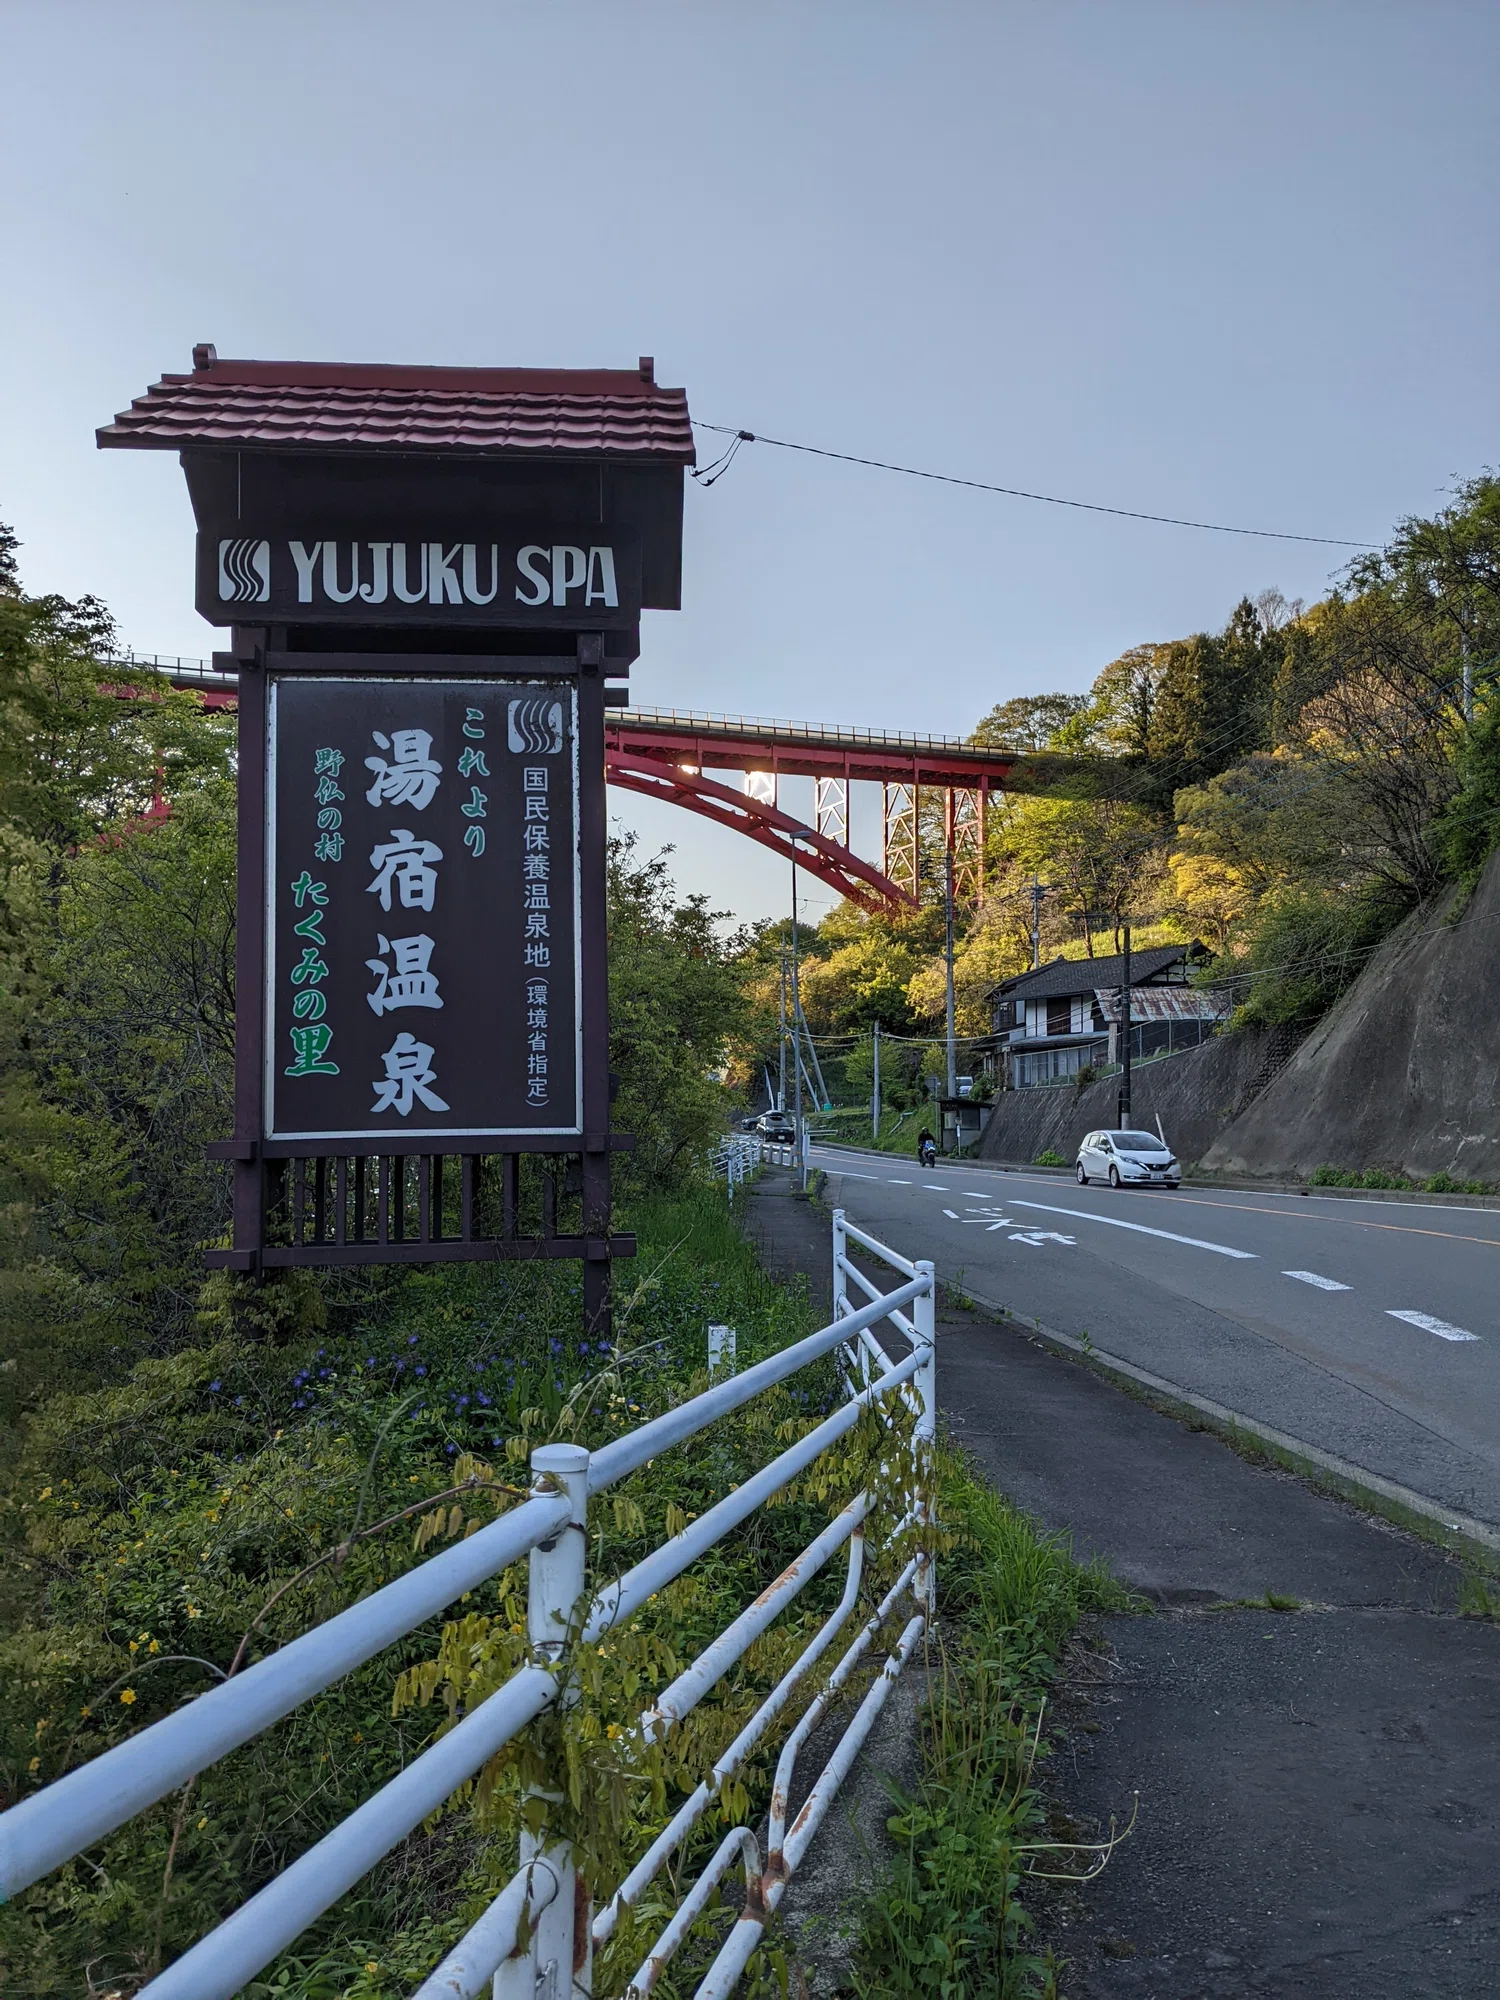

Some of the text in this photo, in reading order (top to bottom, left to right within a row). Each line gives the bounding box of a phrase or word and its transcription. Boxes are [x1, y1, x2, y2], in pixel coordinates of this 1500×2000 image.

[288, 541, 619, 607] YUJUKU SPA
[315, 747, 345, 862] 野仏の村
[458, 707, 490, 857] これより
[284, 871, 340, 1076] たくみの里
[364, 728, 451, 1117] 湯宿温泉
